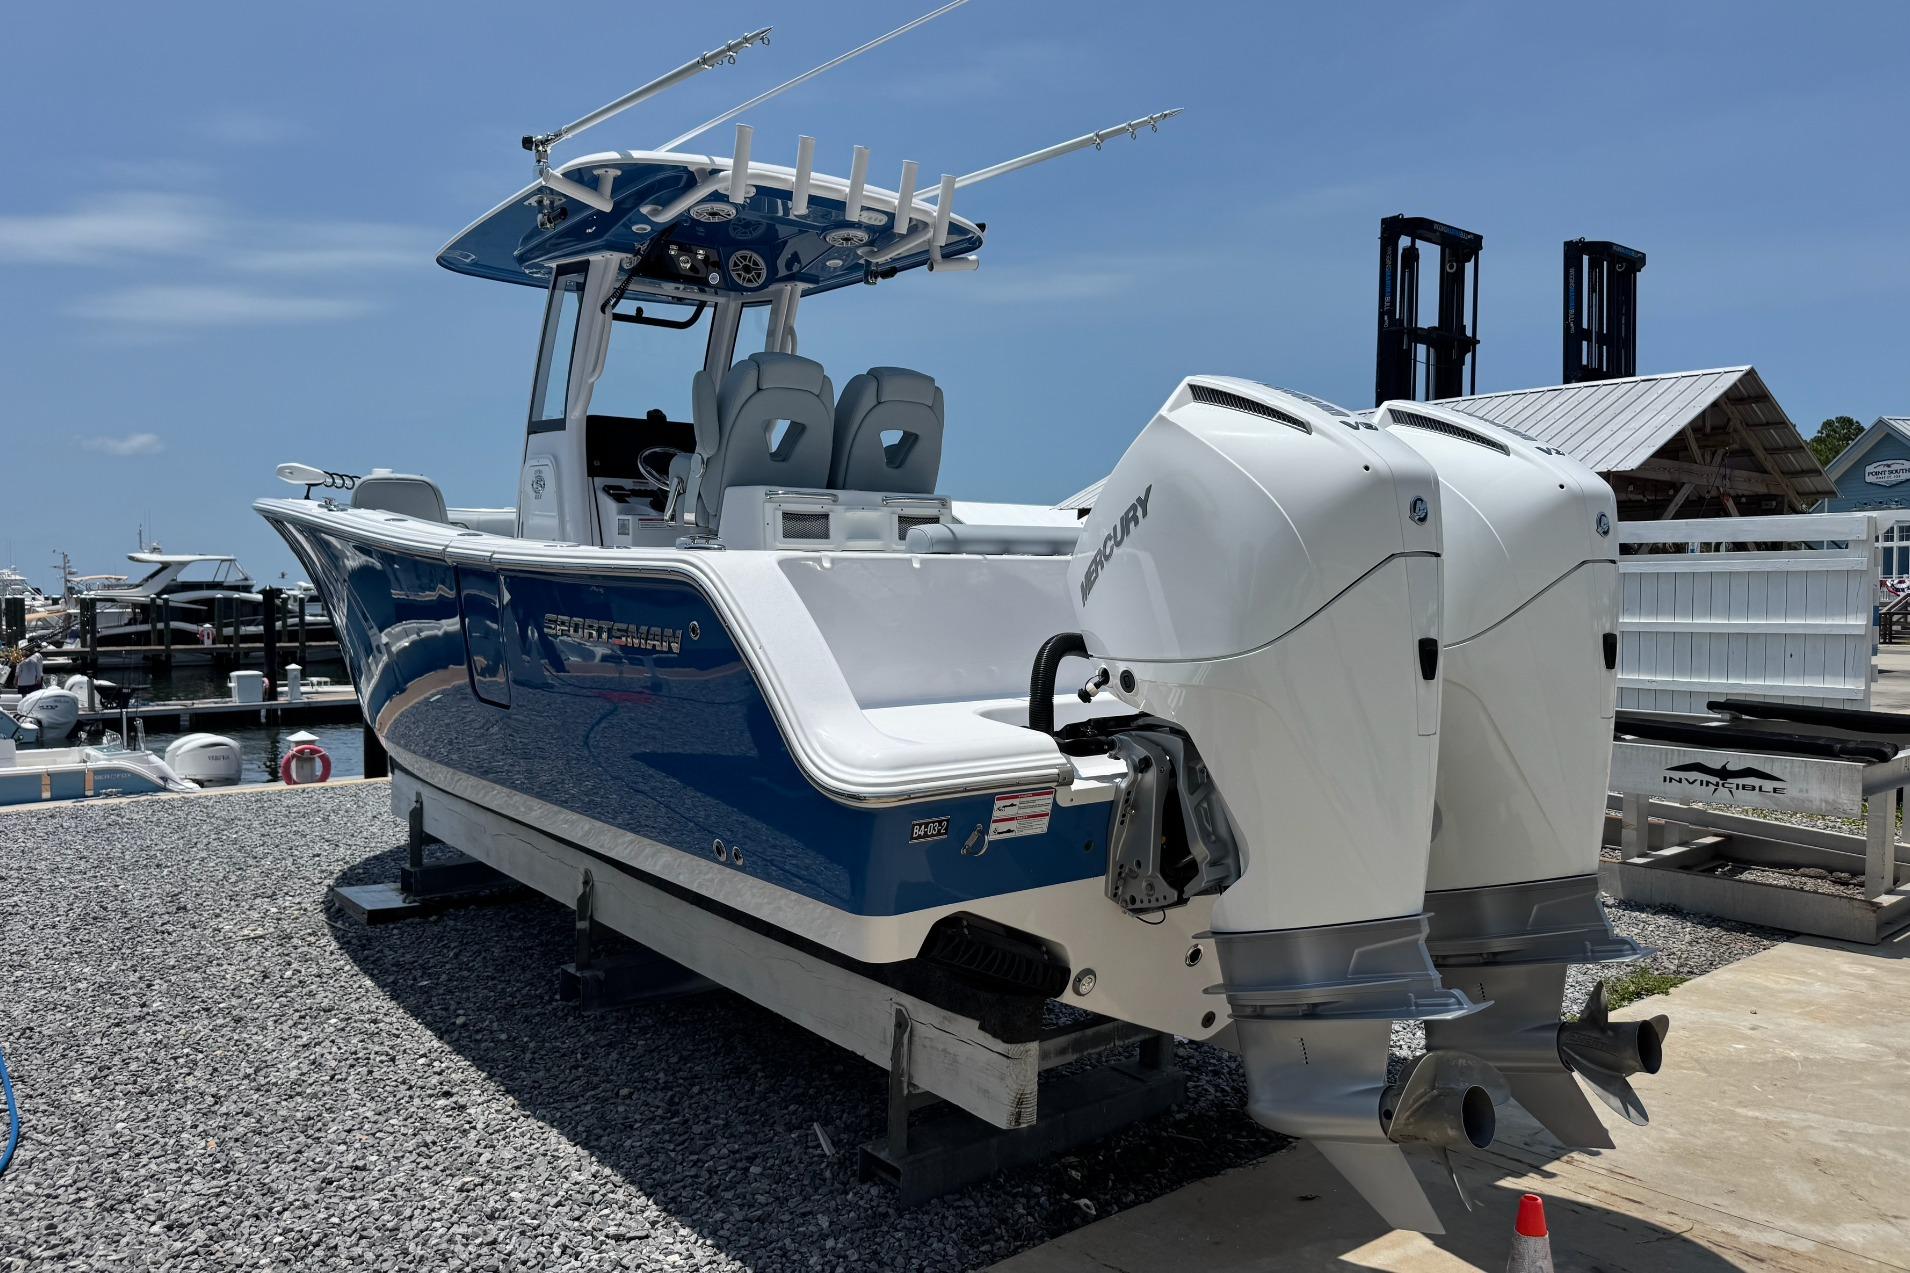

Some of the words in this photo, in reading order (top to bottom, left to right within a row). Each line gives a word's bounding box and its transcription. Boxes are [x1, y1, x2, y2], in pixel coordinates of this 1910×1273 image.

[1080, 484, 1152, 608] MERCURY
[543, 613, 682, 654] SPORTSMAN
[1662, 775, 1787, 795] INVINCIBLE
[912, 821, 948, 838] B4-03-2
